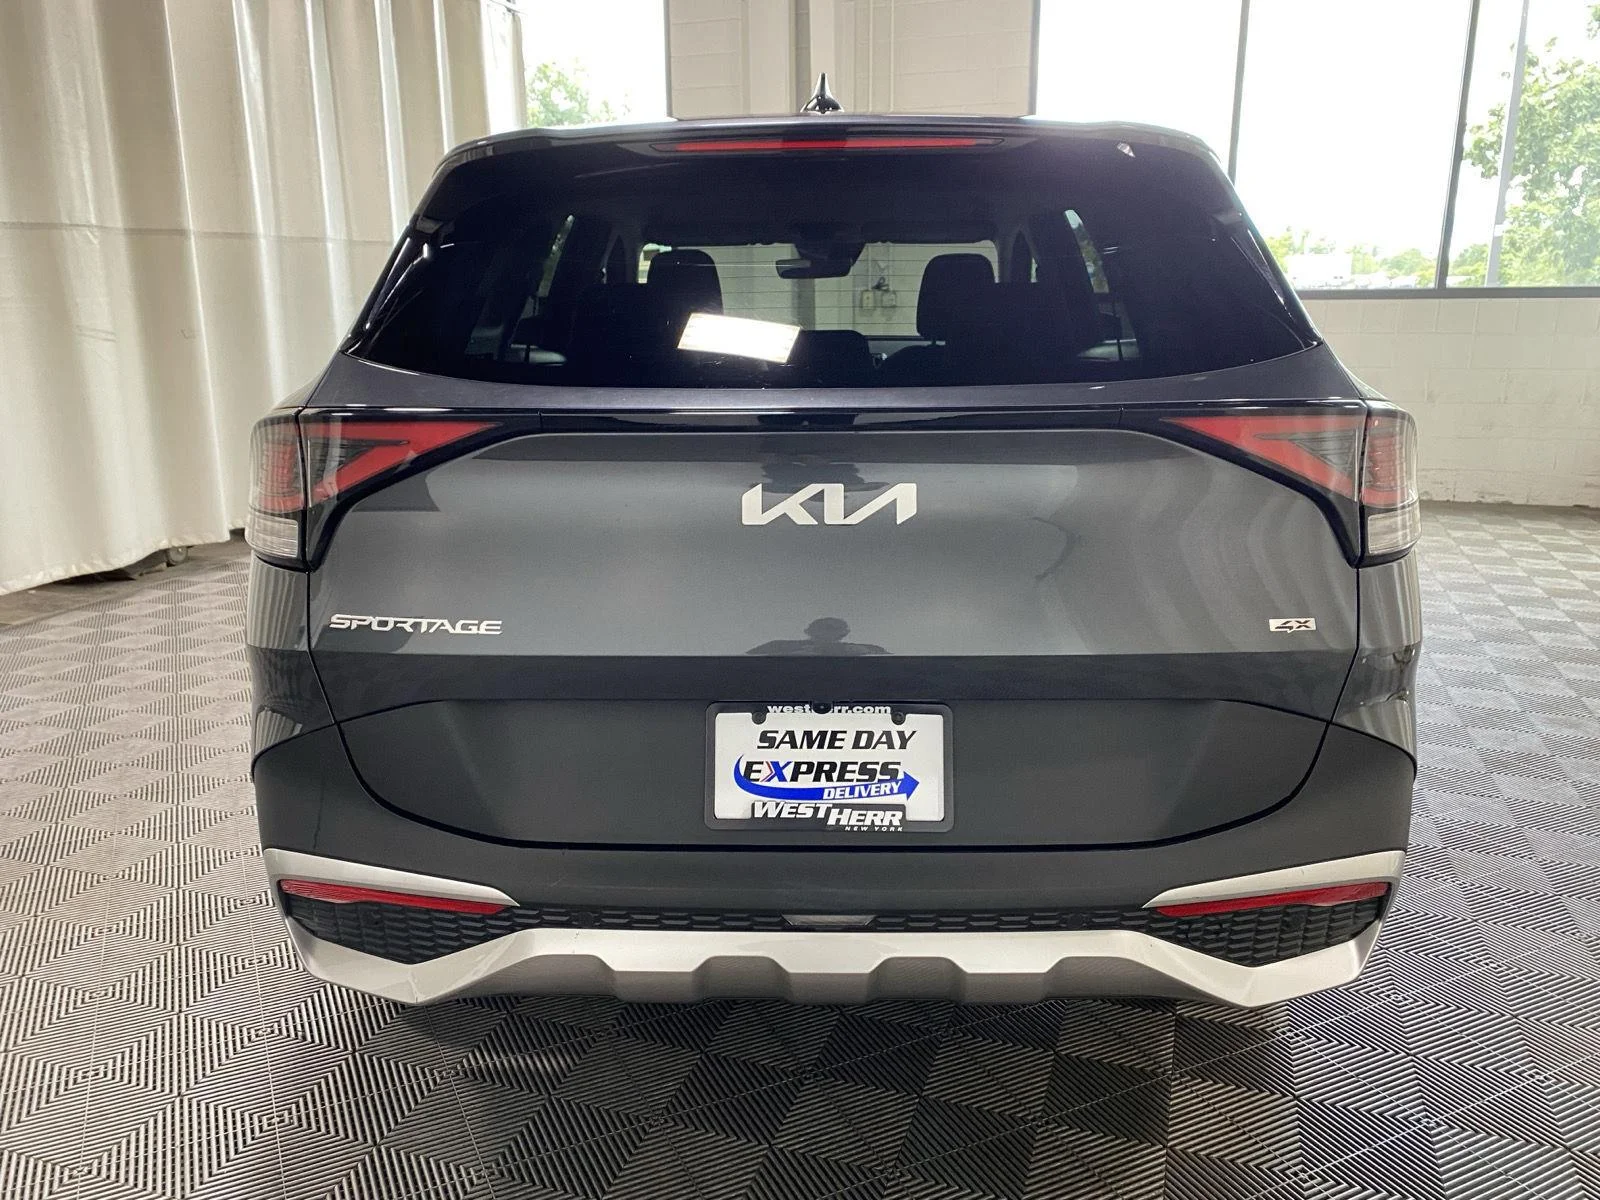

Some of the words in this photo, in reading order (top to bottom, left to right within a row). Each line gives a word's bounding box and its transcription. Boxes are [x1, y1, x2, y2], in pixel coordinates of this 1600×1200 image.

[329, 614, 502, 634] SPORTAGE
[767, 704, 891, 714] westrr.com
[757, 730, 847, 750] SAME
[852, 730, 917, 750] DAY
[743, 761, 901, 782] EXPRESS
[822, 781, 902, 801] DELIVERY
[754, 801, 833, 818] WEST
[827, 808, 903, 826] HERR
